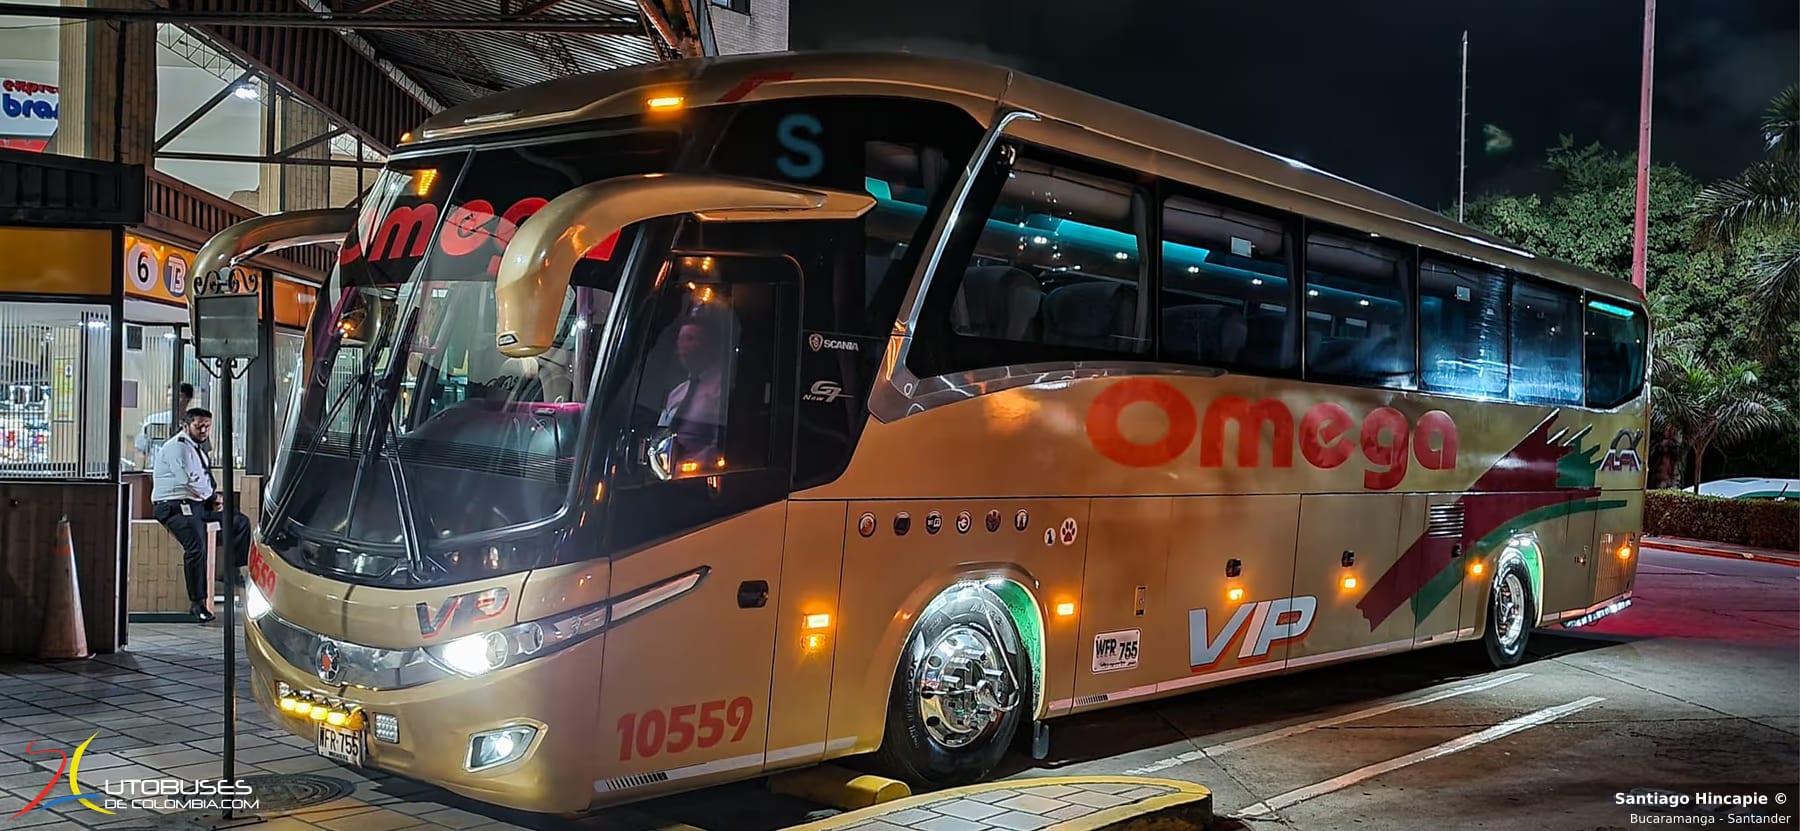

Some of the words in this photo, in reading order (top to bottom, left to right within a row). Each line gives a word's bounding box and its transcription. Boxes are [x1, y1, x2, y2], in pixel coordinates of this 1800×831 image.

[777, 114, 823, 178] S
[137, 251, 150, 283] 6
[823, 339, 859, 351] SCANIA
[1085, 376, 1460, 491] Omega
[415, 587, 511, 639] VIP
[1187, 595, 1318, 673] VIP
[1095, 638, 1117, 658] WFR
[1119, 640, 1138, 660] 755
[617, 696, 753, 761] 10559
